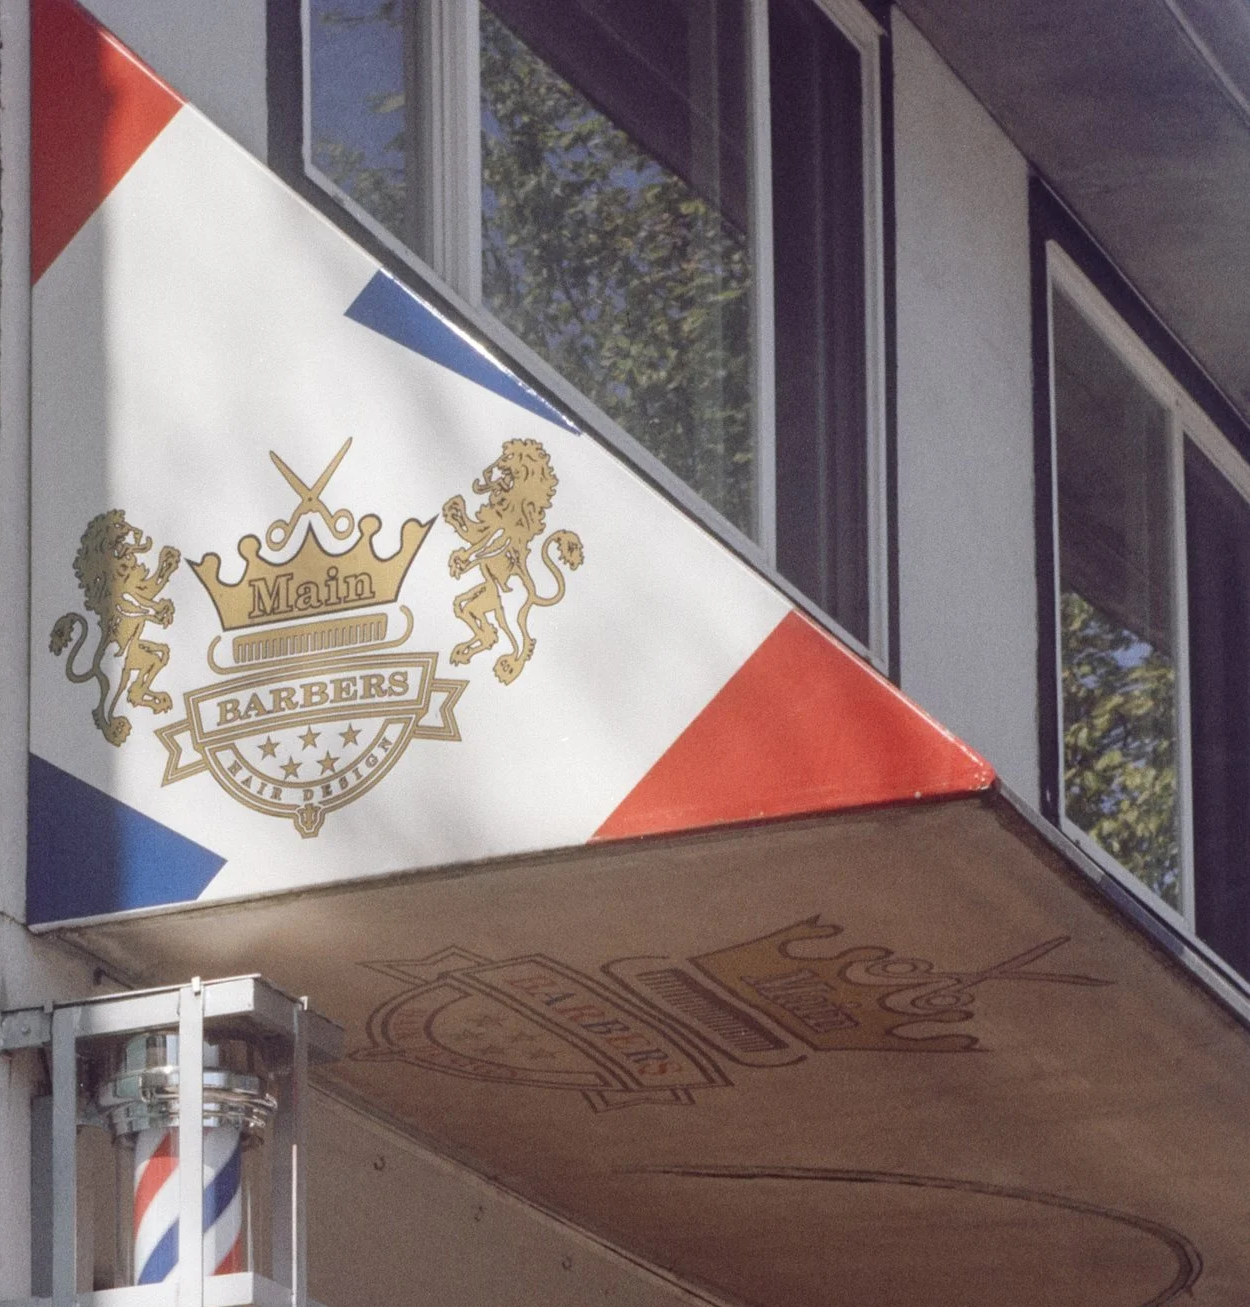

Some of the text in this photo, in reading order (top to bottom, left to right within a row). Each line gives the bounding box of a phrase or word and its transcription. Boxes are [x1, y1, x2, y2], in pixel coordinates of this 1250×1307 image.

[248, 566, 376, 619] Main
[217, 671, 410, 726] BARBERS
[227, 737, 393, 801] HAIR DESIGN
[502, 972, 683, 1078] BARBERS
